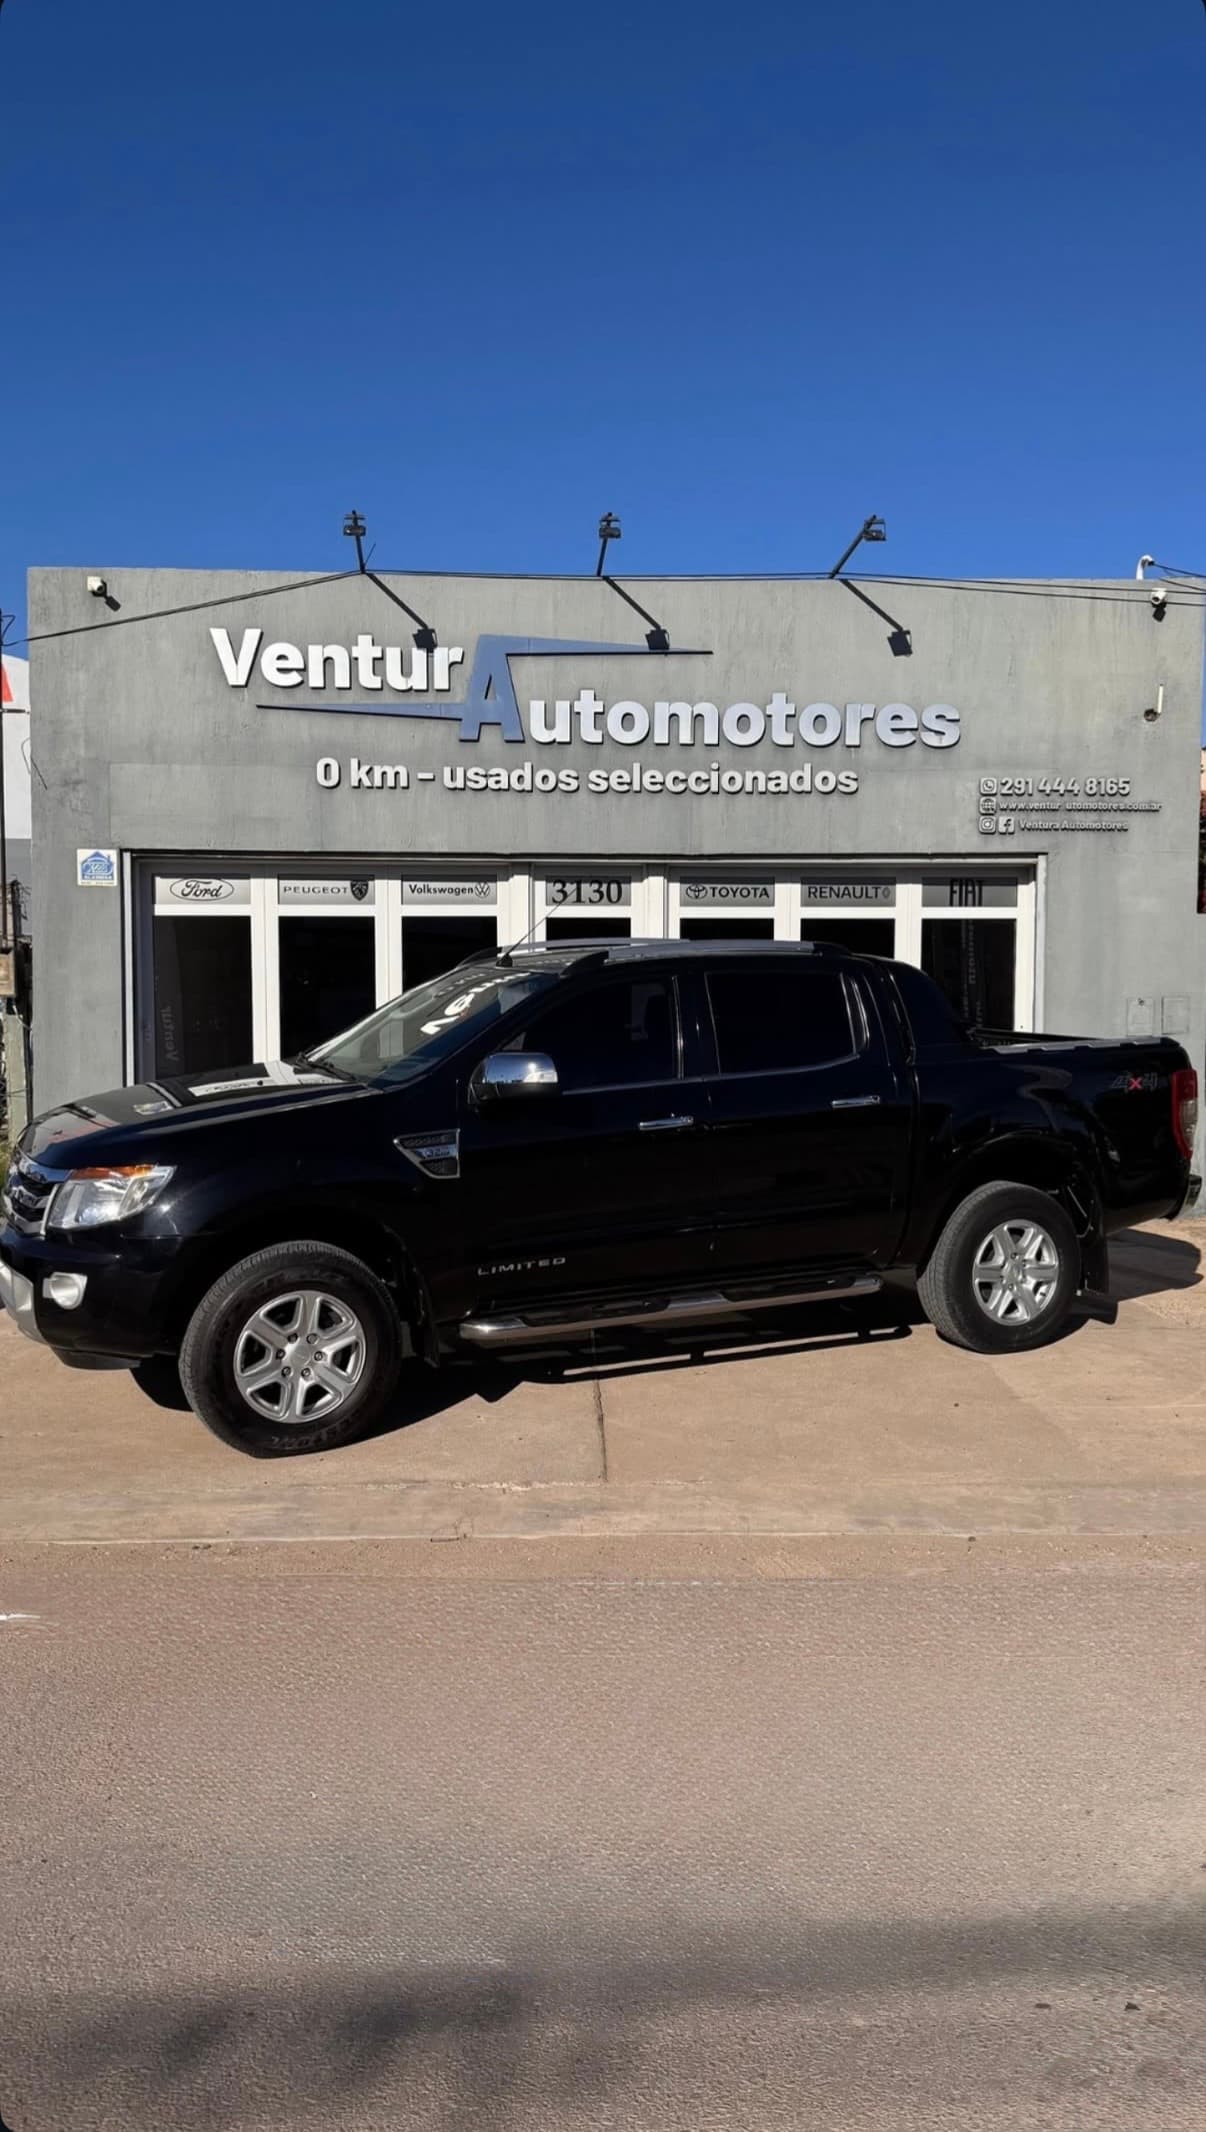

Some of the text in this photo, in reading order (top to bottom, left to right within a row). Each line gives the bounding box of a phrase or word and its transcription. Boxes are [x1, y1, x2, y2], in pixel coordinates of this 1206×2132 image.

[209, 627, 464, 692] Ventur
[316, 757, 341, 789] 0
[349, 757, 409, 790] km
[443, 761, 580, 793] usados
[587, 762, 859, 794] seleccionados
[1000, 777, 1131, 797] 291 444 8165
[181, 880, 223, 898] Ford
[283, 885, 349, 895] PEUGEOT
[408, 883, 475, 895] Volkswagen
[552, 879, 623, 904] 3130
[709, 885, 770, 900] TOYOTA
[807, 885, 882, 900] RENAULT
[949, 878, 985, 907] FIAT
[477, 1256, 567, 1277] LIMITED
